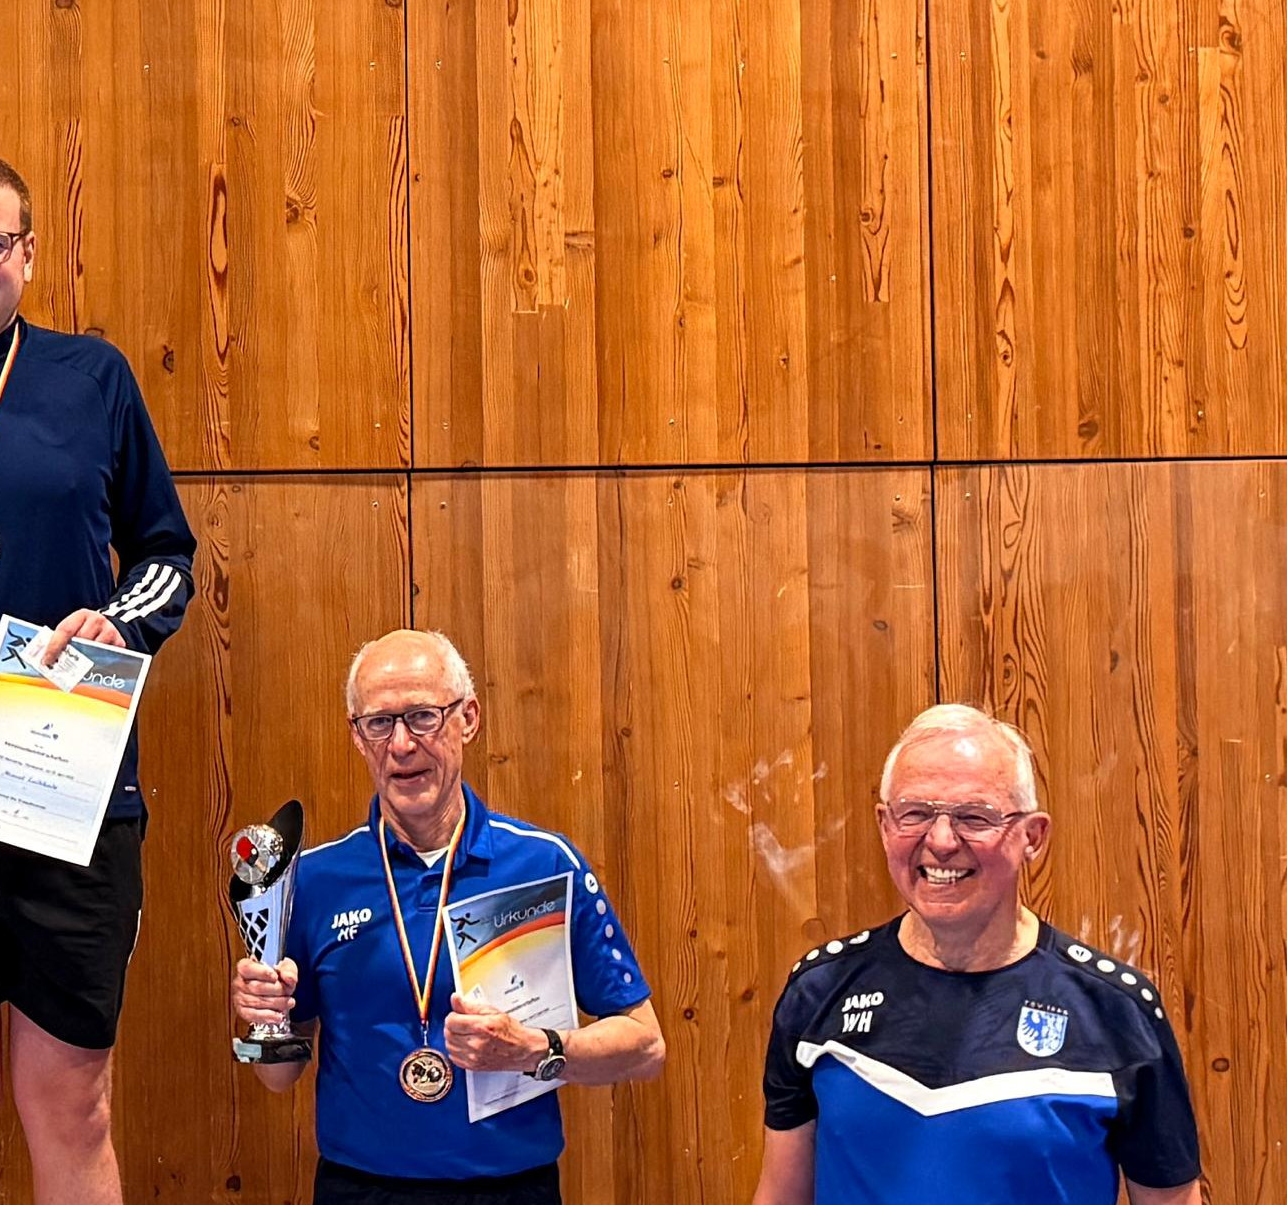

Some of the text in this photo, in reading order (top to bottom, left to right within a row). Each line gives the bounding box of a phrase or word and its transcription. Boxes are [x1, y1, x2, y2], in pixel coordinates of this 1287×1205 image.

[83, 672, 126, 689] unde
[331, 908, 372, 929] JAKO
[494, 900, 556, 929] Urkunde
[841, 992, 884, 1012] JAKO
[841, 1011, 873, 1033] WH
